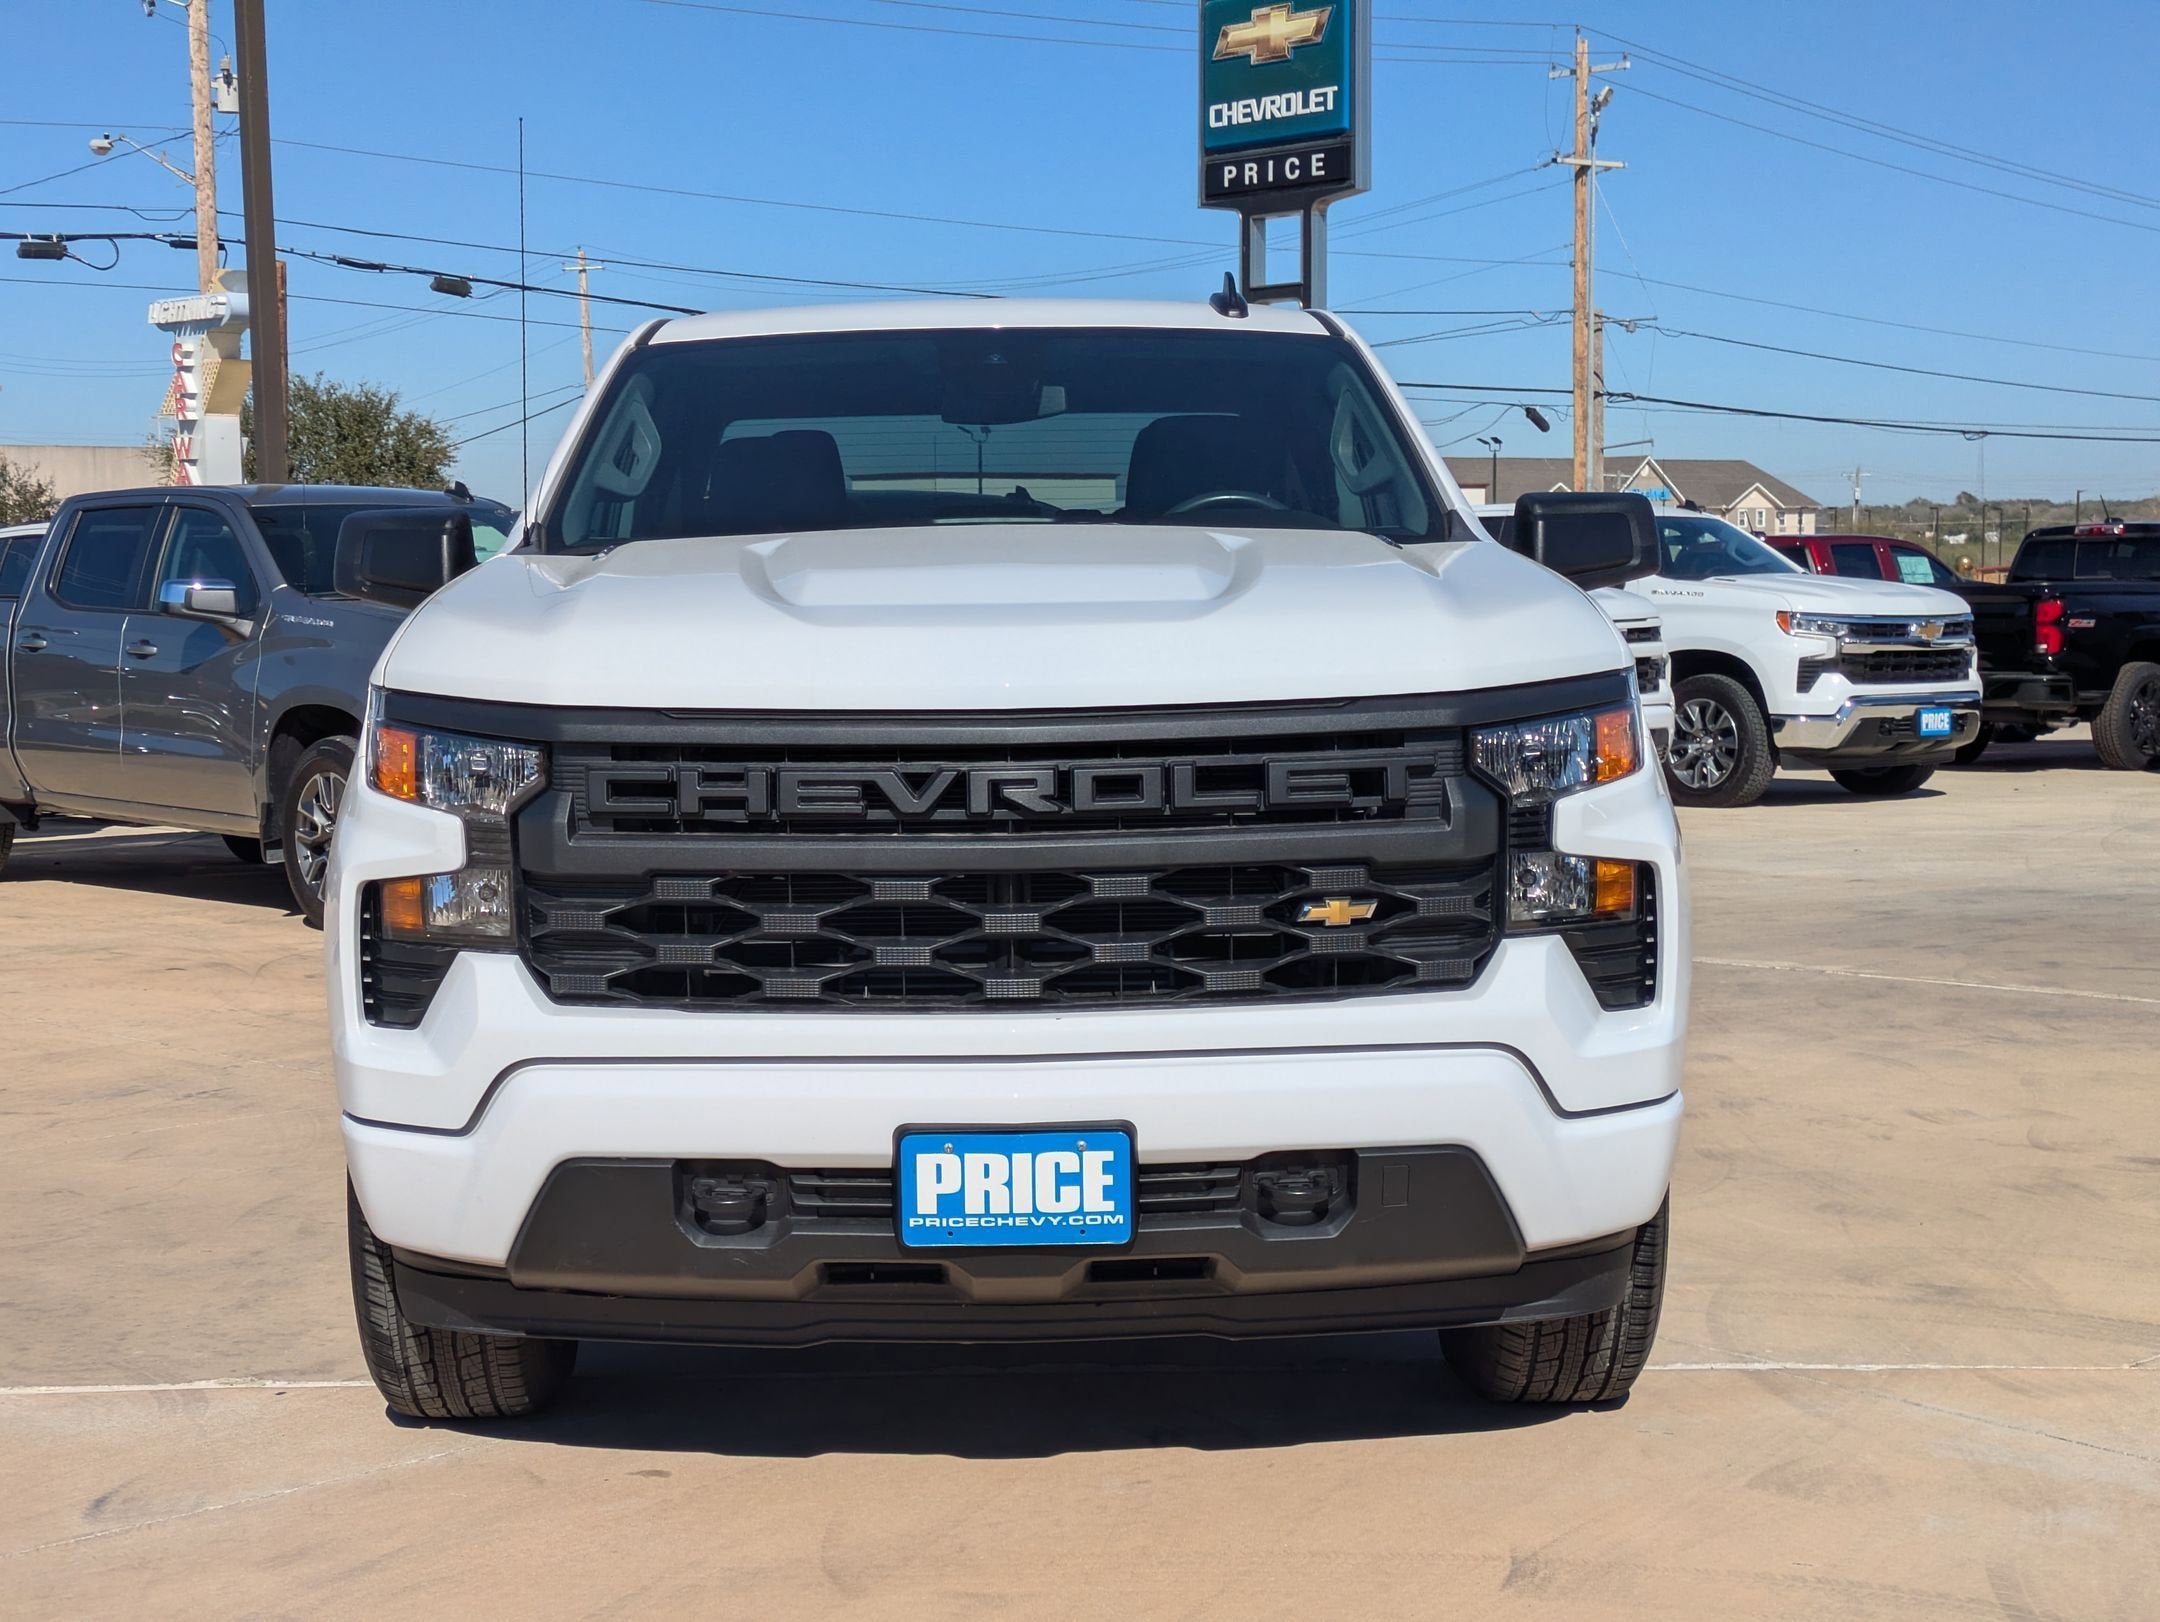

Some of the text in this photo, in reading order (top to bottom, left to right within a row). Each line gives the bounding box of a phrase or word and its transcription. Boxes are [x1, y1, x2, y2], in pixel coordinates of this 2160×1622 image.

[1209, 86, 1338, 128] CHEVROLET
[1223, 153, 1326, 187] PRICE
[171, 342, 190, 420] CAR
[1922, 712, 1950, 731] PRICE
[586, 753, 1438, 818] CHEVROLET
[916, 1150, 1116, 1215] PRICE
[909, 1215, 1124, 1227] PRICECHEVY.COM
